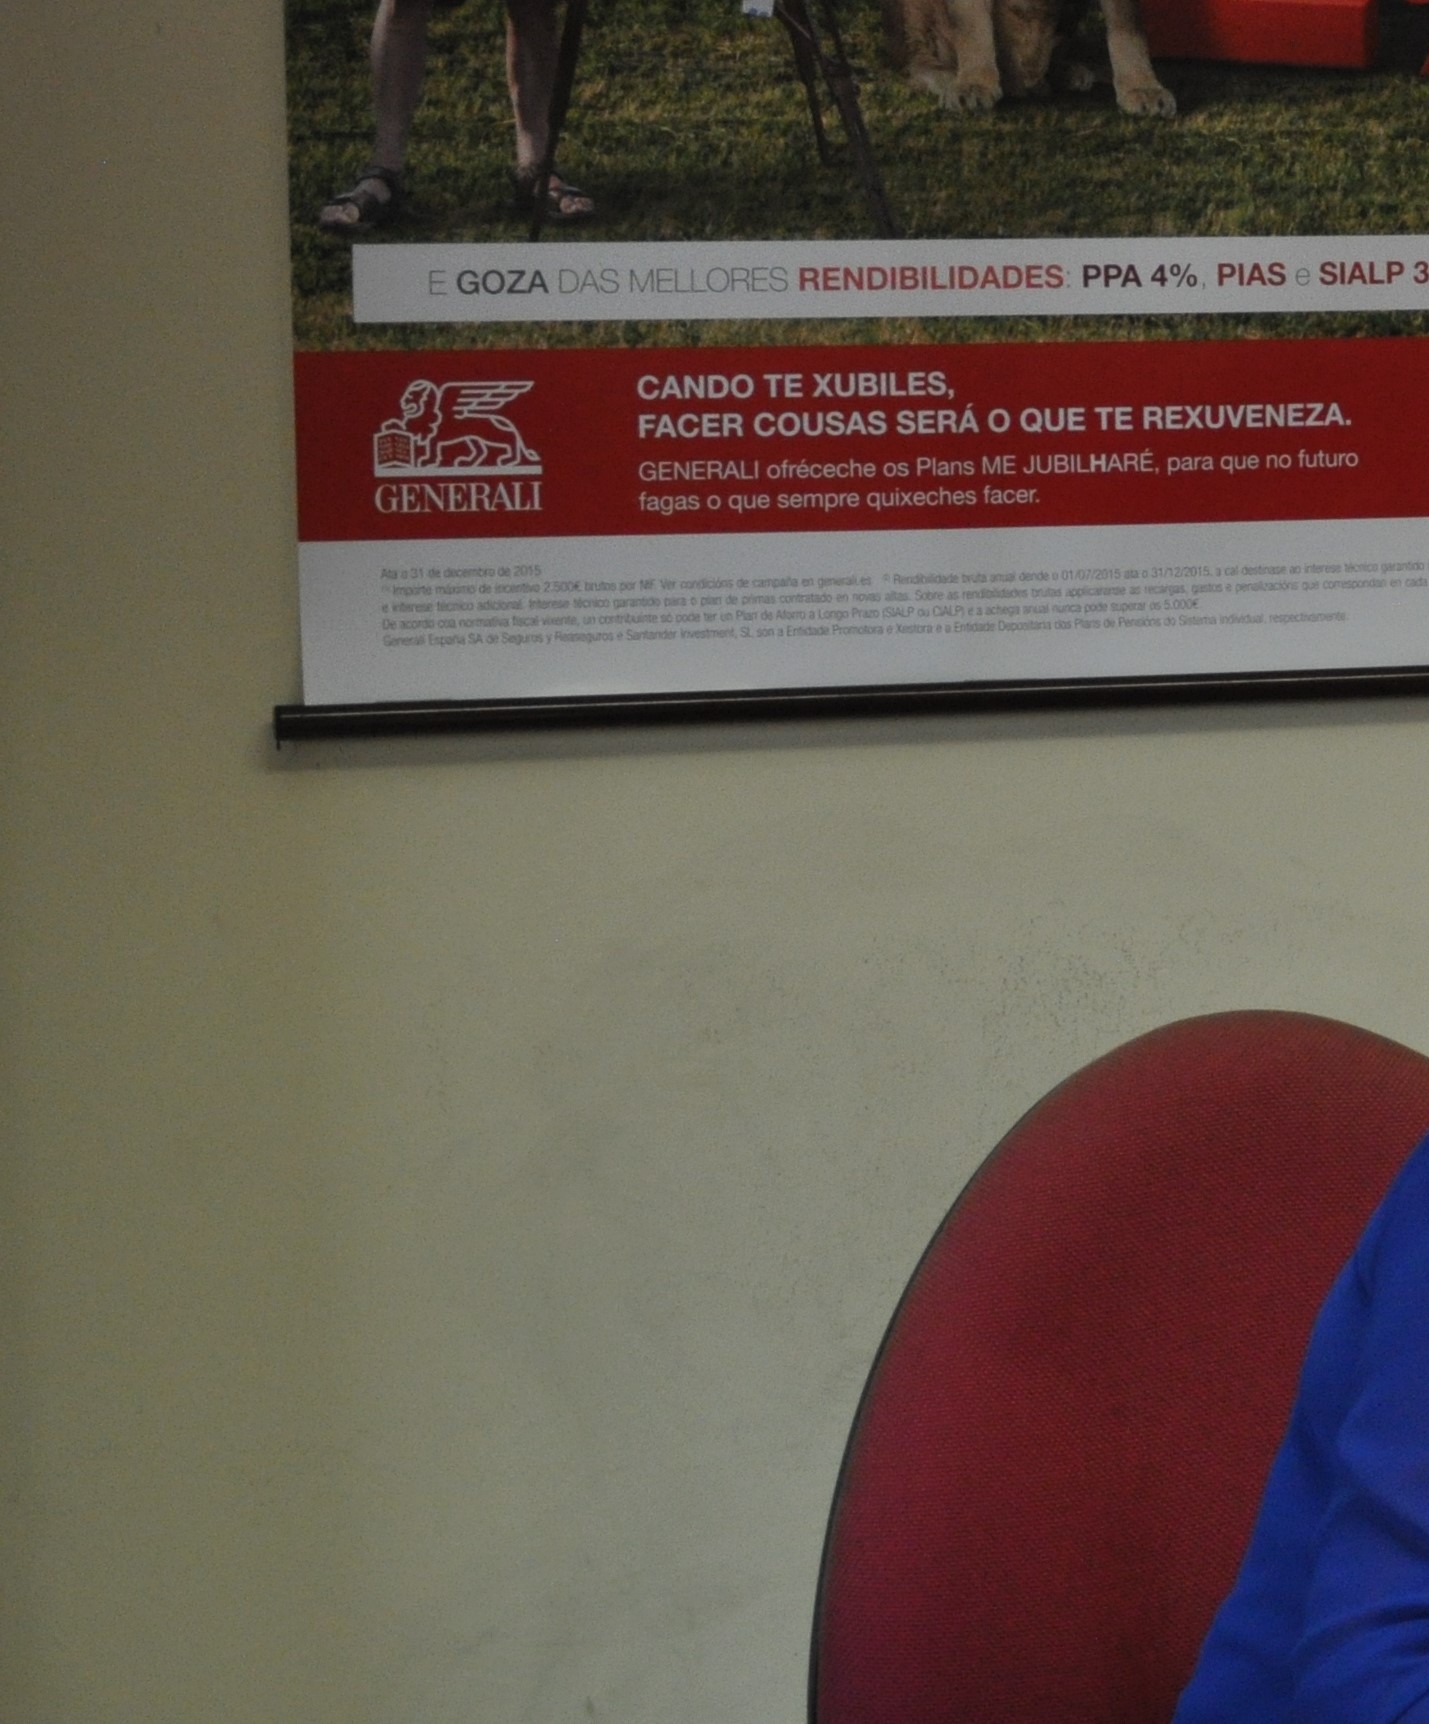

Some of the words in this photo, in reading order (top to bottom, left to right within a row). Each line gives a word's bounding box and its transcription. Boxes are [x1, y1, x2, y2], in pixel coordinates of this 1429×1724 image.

[428, 269, 447, 296] E
[455, 269, 549, 296] GOZA
[558, 267, 621, 295] DAS
[629, 266, 789, 295] MELLORES
[799, 263, 1072, 293] RENDIBILIDADES:
[1082, 262, 1143, 289] PPA
[1150, 261, 1207, 292] 4%,
[1216, 260, 1286, 288] PIAS
[1295, 265, 1312, 287] e
[1318, 259, 1406, 287] SIALP
[636, 373, 754, 399] CANDO
[763, 373, 804, 397] TE
[811, 370, 955, 401] XUBILES,
[637, 412, 743, 438] FACER
[752, 411, 888, 437] COUSAS
[896, 404, 979, 434] SERÁ
[987, 407, 1010, 431] O
[1019, 405, 1086, 434] QUE
[1094, 405, 1133, 430] TE
[1142, 402, 1353, 430] REXUVENEZA.
[638, 460, 759, 483] GENERALI
[766, 457, 875, 480] ofréceche
[882, 462, 910, 479] os
[916, 455, 976, 478] Plans
[981, 454, 1017, 475] ME
[1023, 449, 1160, 479] JUBILHARÉ,
[1167, 457, 1214, 477] para
[1221, 455, 1260, 476] que
[1265, 453, 1292, 470] no
[1298, 449, 1360, 470] futuro
[374, 480, 543, 514] GENERALI
[639, 489, 699, 516] fagas
[705, 495, 721, 511] o
[728, 494, 769, 516] que
[776, 492, 861, 515] sempre
[866, 485, 977, 512] quixeches
[983, 485, 1040, 505] facer.
[514, 565, 541, 576] 2015
[1061, 569, 1120, 581] 01/07/2015
